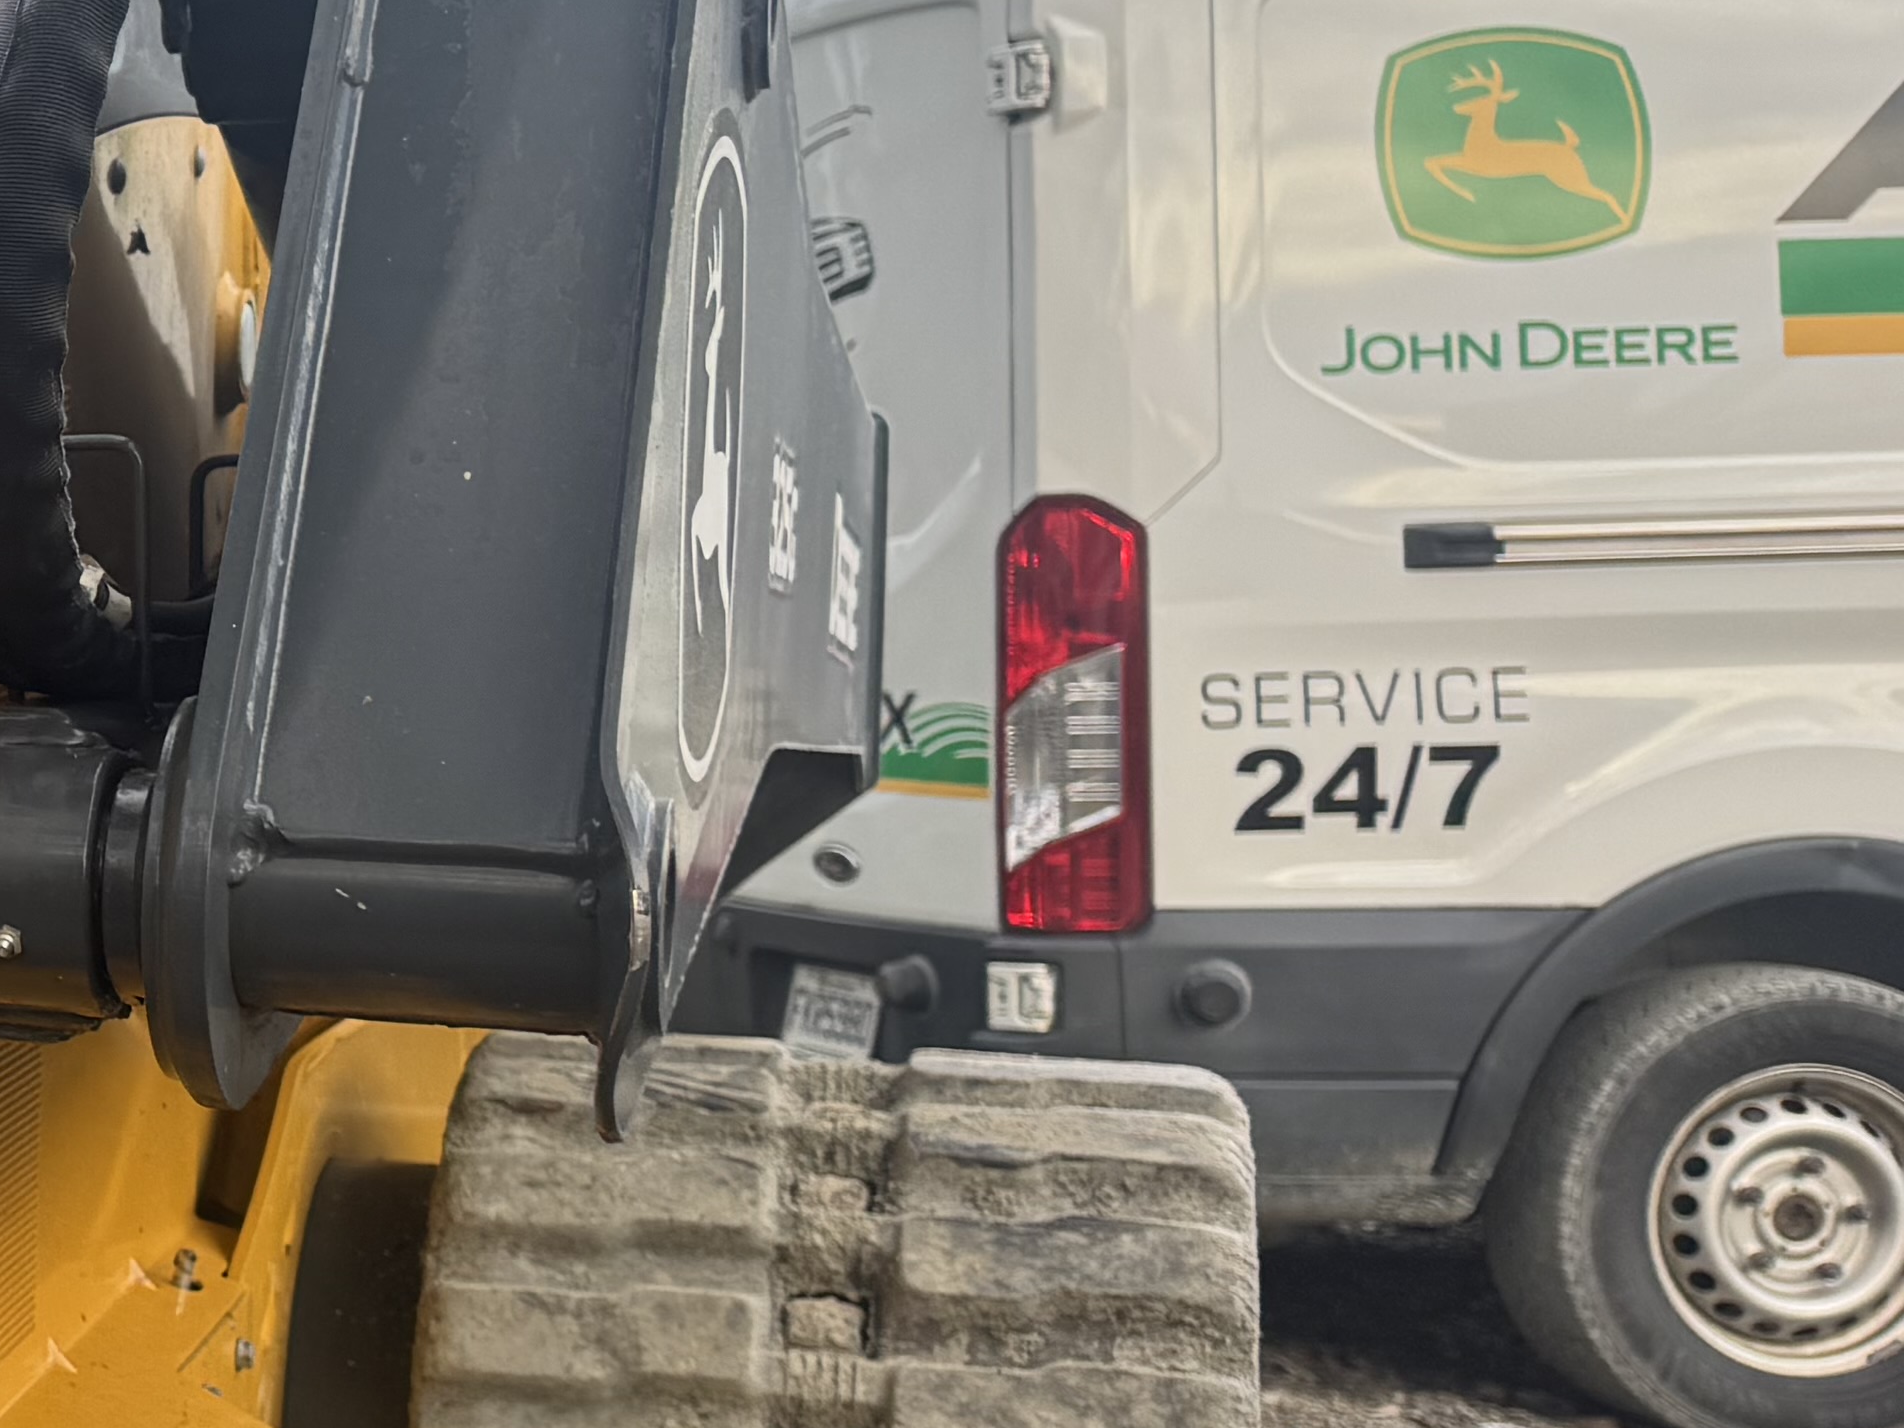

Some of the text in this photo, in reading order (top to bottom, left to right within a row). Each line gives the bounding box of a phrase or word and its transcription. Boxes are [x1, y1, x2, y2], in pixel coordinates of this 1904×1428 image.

[1318, 318, 1740, 375] JOHN DEERE
[1199, 666, 1531, 732] SERVICE
[1233, 742, 1501, 834] 24/7
